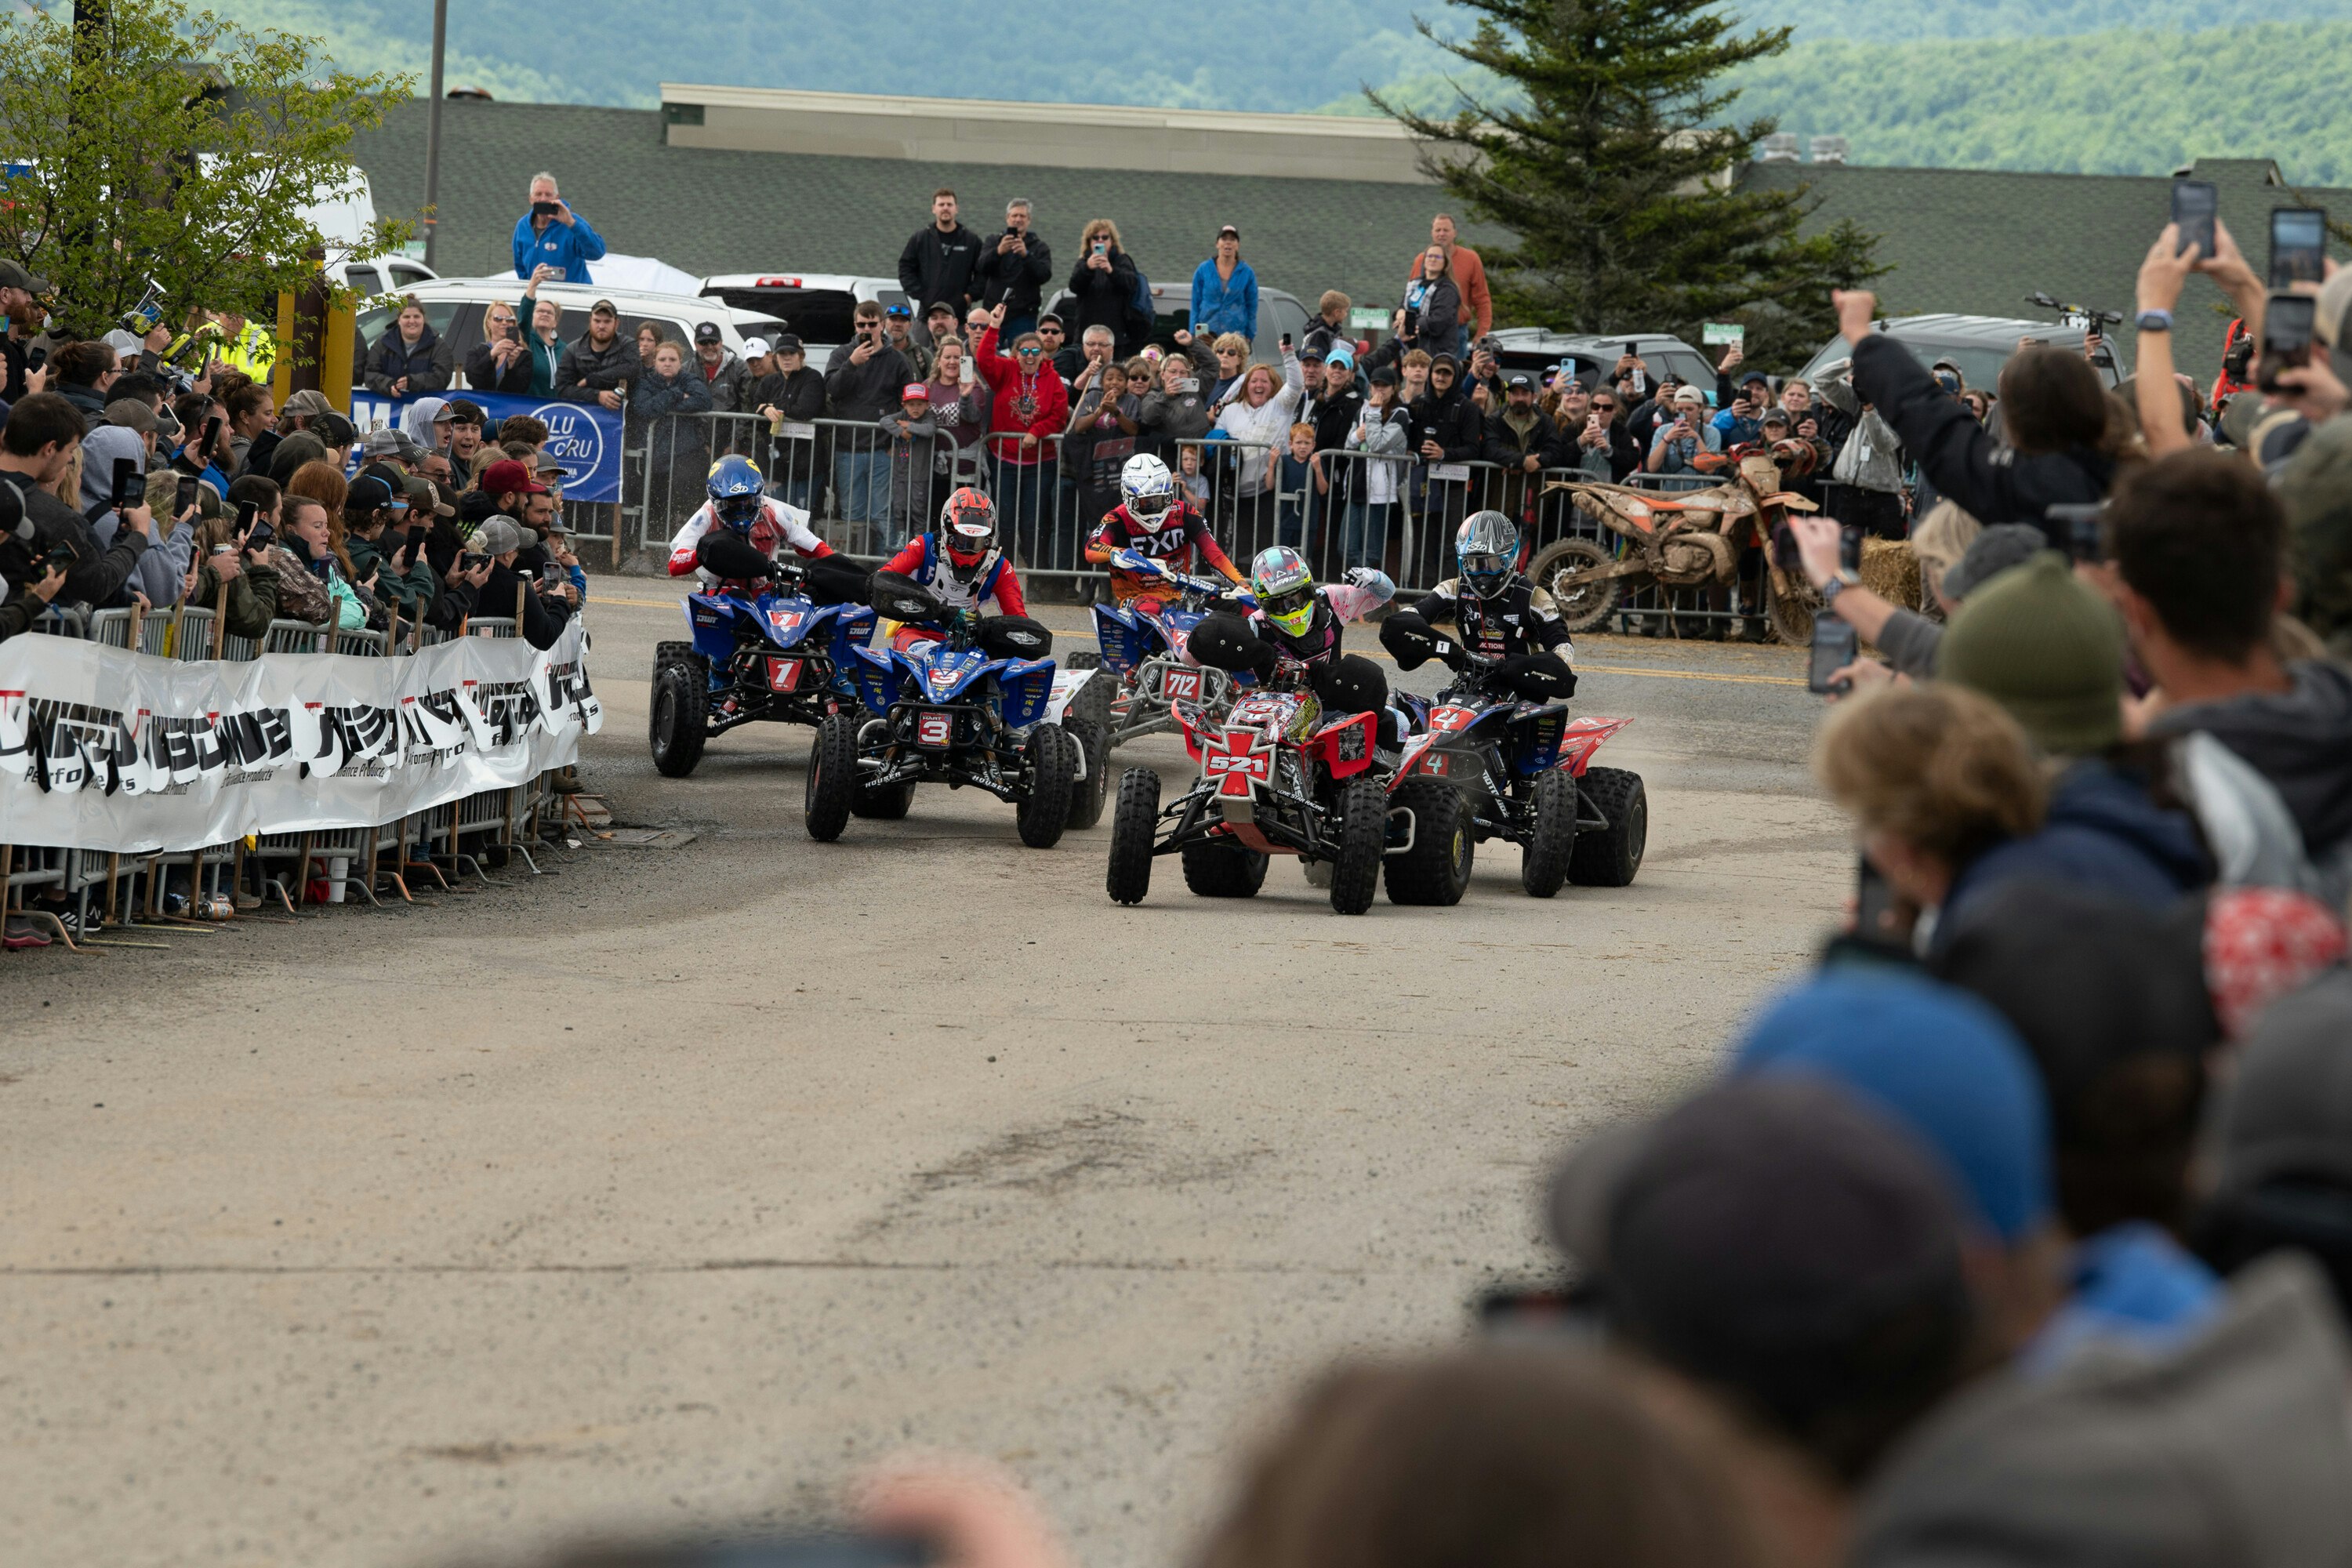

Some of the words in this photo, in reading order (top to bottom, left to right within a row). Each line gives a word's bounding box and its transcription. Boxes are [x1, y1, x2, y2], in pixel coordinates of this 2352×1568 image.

[955, 490, 991, 509] FLY
[1131, 528, 1185, 556] FXR
[775, 663, 793, 683] 1
[931, 670, 958, 684] 3
[1167, 673, 1197, 696] 712
[1432, 710, 1459, 729] 4
[921, 721, 948, 742] 3
[1210, 756, 1265, 772] 521
[1427, 753, 1443, 774] 4
[866, 771, 901, 788] HOUSER
[972, 775, 1009, 793] HOUSER
[1276, 789, 1292, 797] LONE
[1290, 793, 1305, 803] STAR
[1305, 800, 1326, 812] RACING
